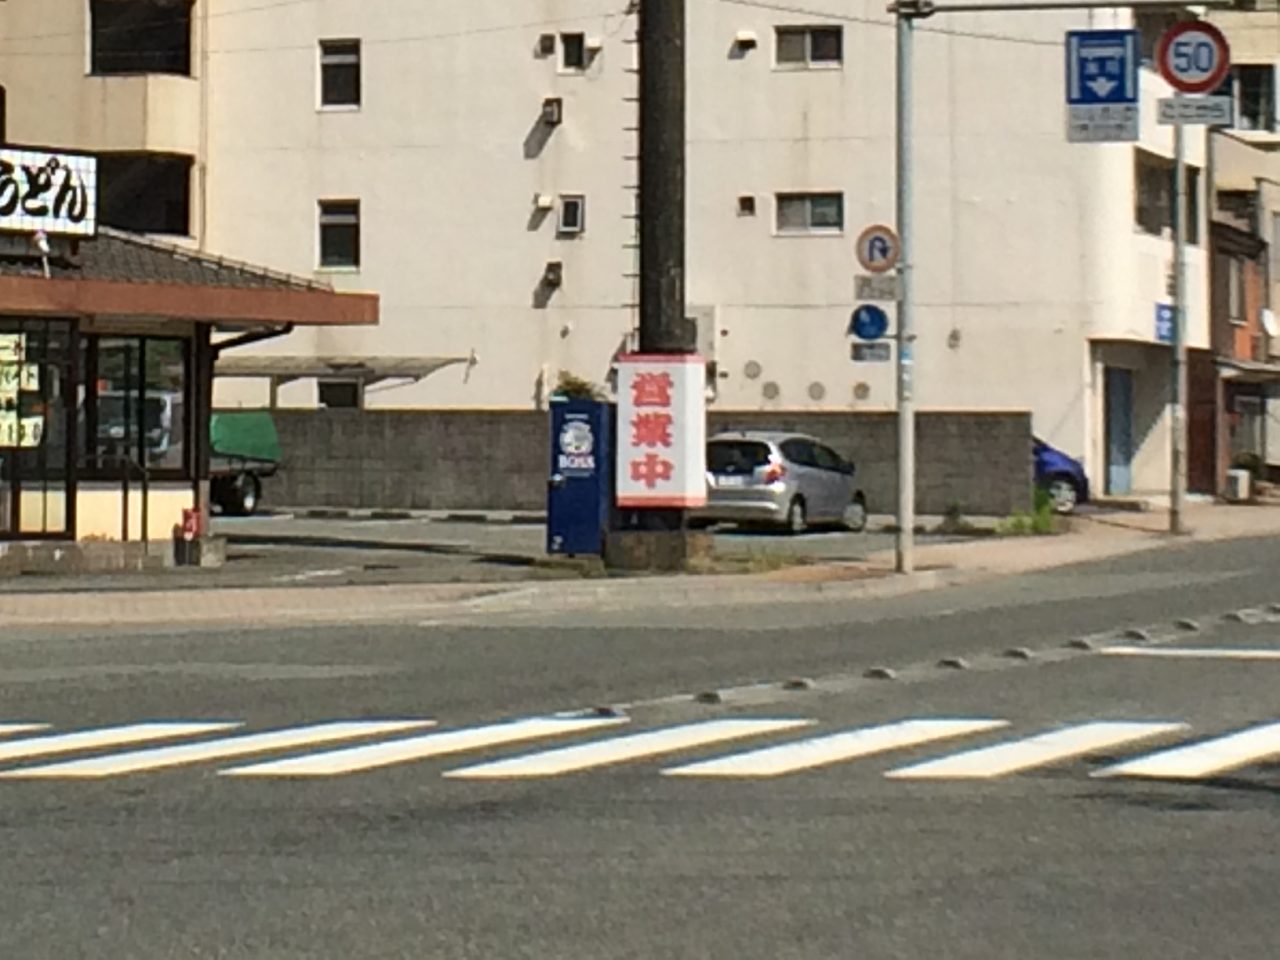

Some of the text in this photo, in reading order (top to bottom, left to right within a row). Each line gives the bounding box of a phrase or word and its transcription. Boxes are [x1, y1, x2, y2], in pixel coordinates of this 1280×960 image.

[1174, 41, 1214, 73] 50
[629, 371, 675, 490] 営業中
